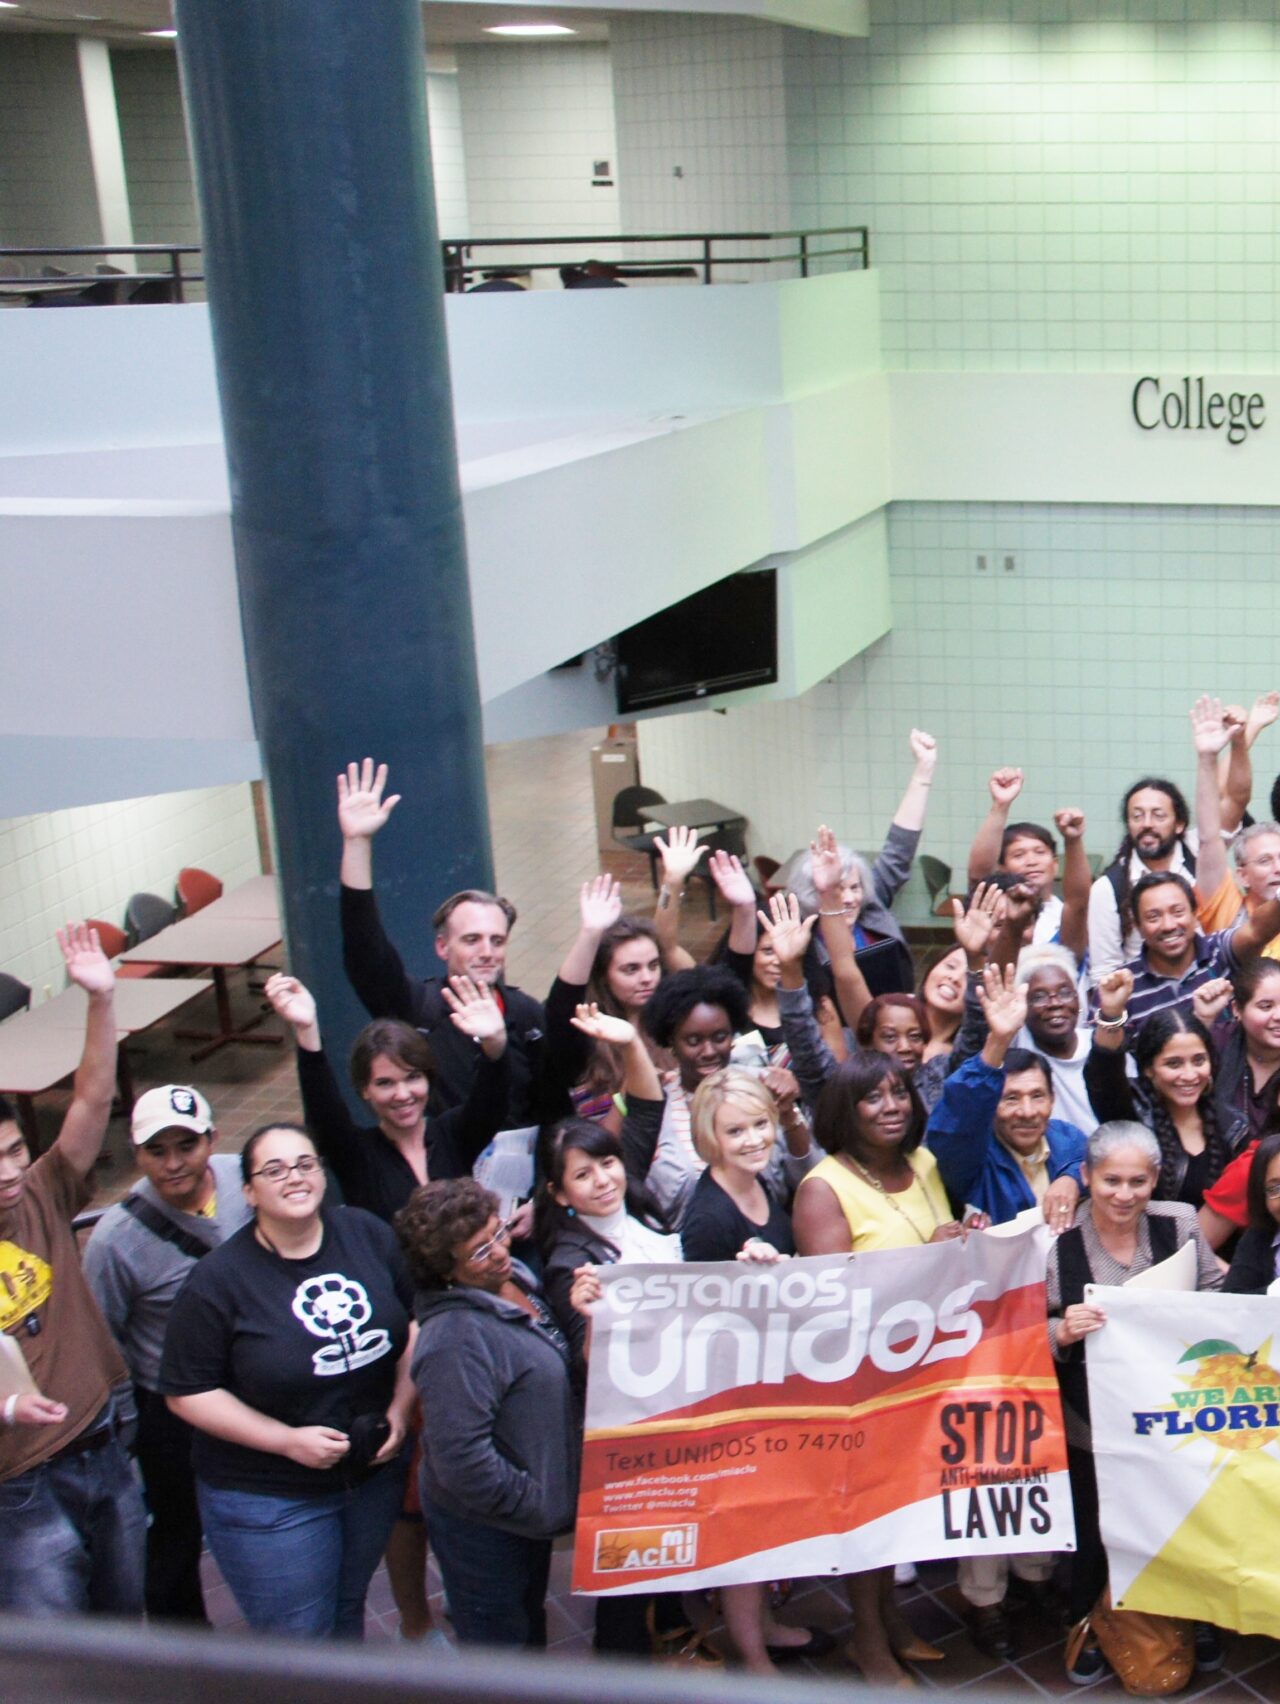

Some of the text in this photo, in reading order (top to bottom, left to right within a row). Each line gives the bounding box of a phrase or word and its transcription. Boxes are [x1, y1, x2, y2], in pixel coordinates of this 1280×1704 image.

[1131, 376, 1266, 445] College
[1171, 1390, 1224, 1409] WE
[940, 1401, 1044, 1465] STOP
[605, 1430, 866, 1472] Text UNIDOS to 74700
[940, 1466, 1049, 1487] ANTI-IMMIGRANT
[602, 1501, 643, 1513] Twitter
[942, 1486, 1052, 1540] LAWS
[661, 1525, 694, 1547] mi
[622, 1544, 693, 1569] ACLU
